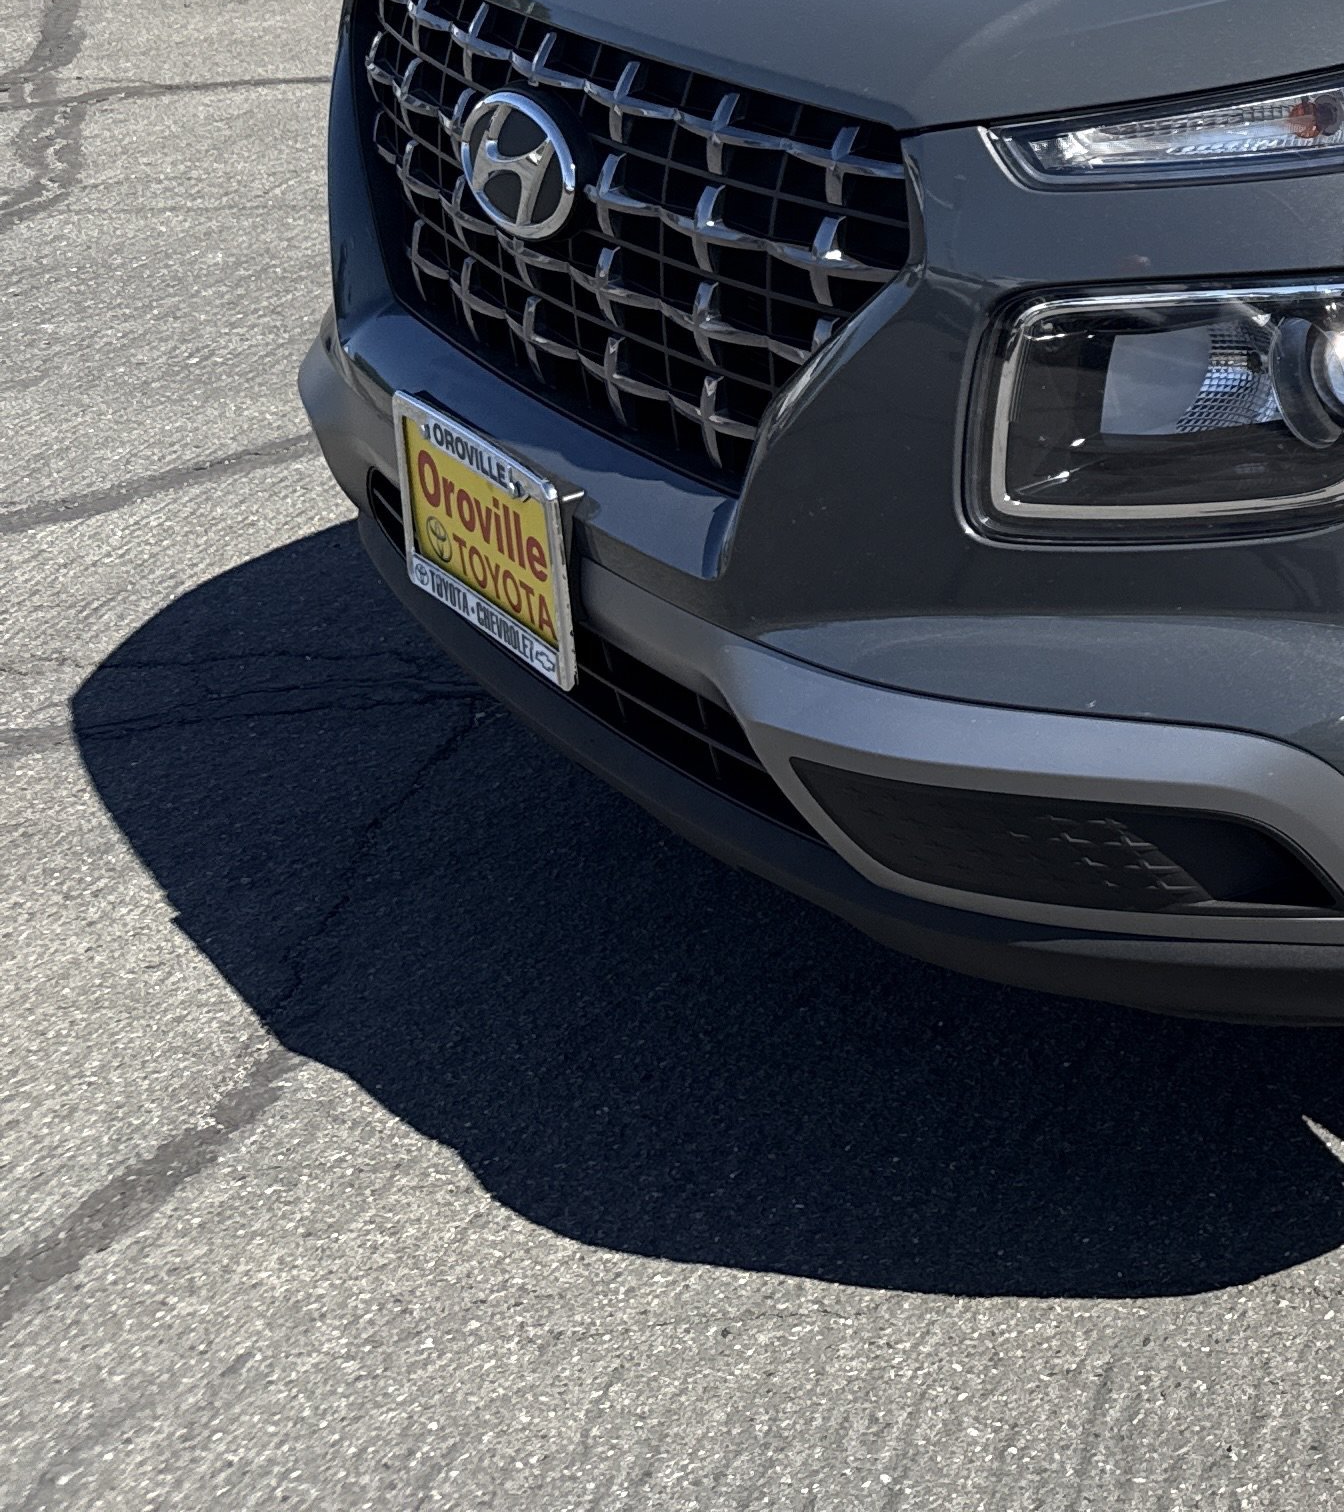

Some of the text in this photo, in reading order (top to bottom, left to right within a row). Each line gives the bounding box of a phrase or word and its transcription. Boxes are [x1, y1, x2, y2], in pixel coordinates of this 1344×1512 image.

[433, 422, 508, 488] OROVILLE
[417, 449, 549, 582] Oroville
[429, 571, 536, 664] TOYOTA CHEVROLET
[452, 532, 558, 642] TOYOTA
